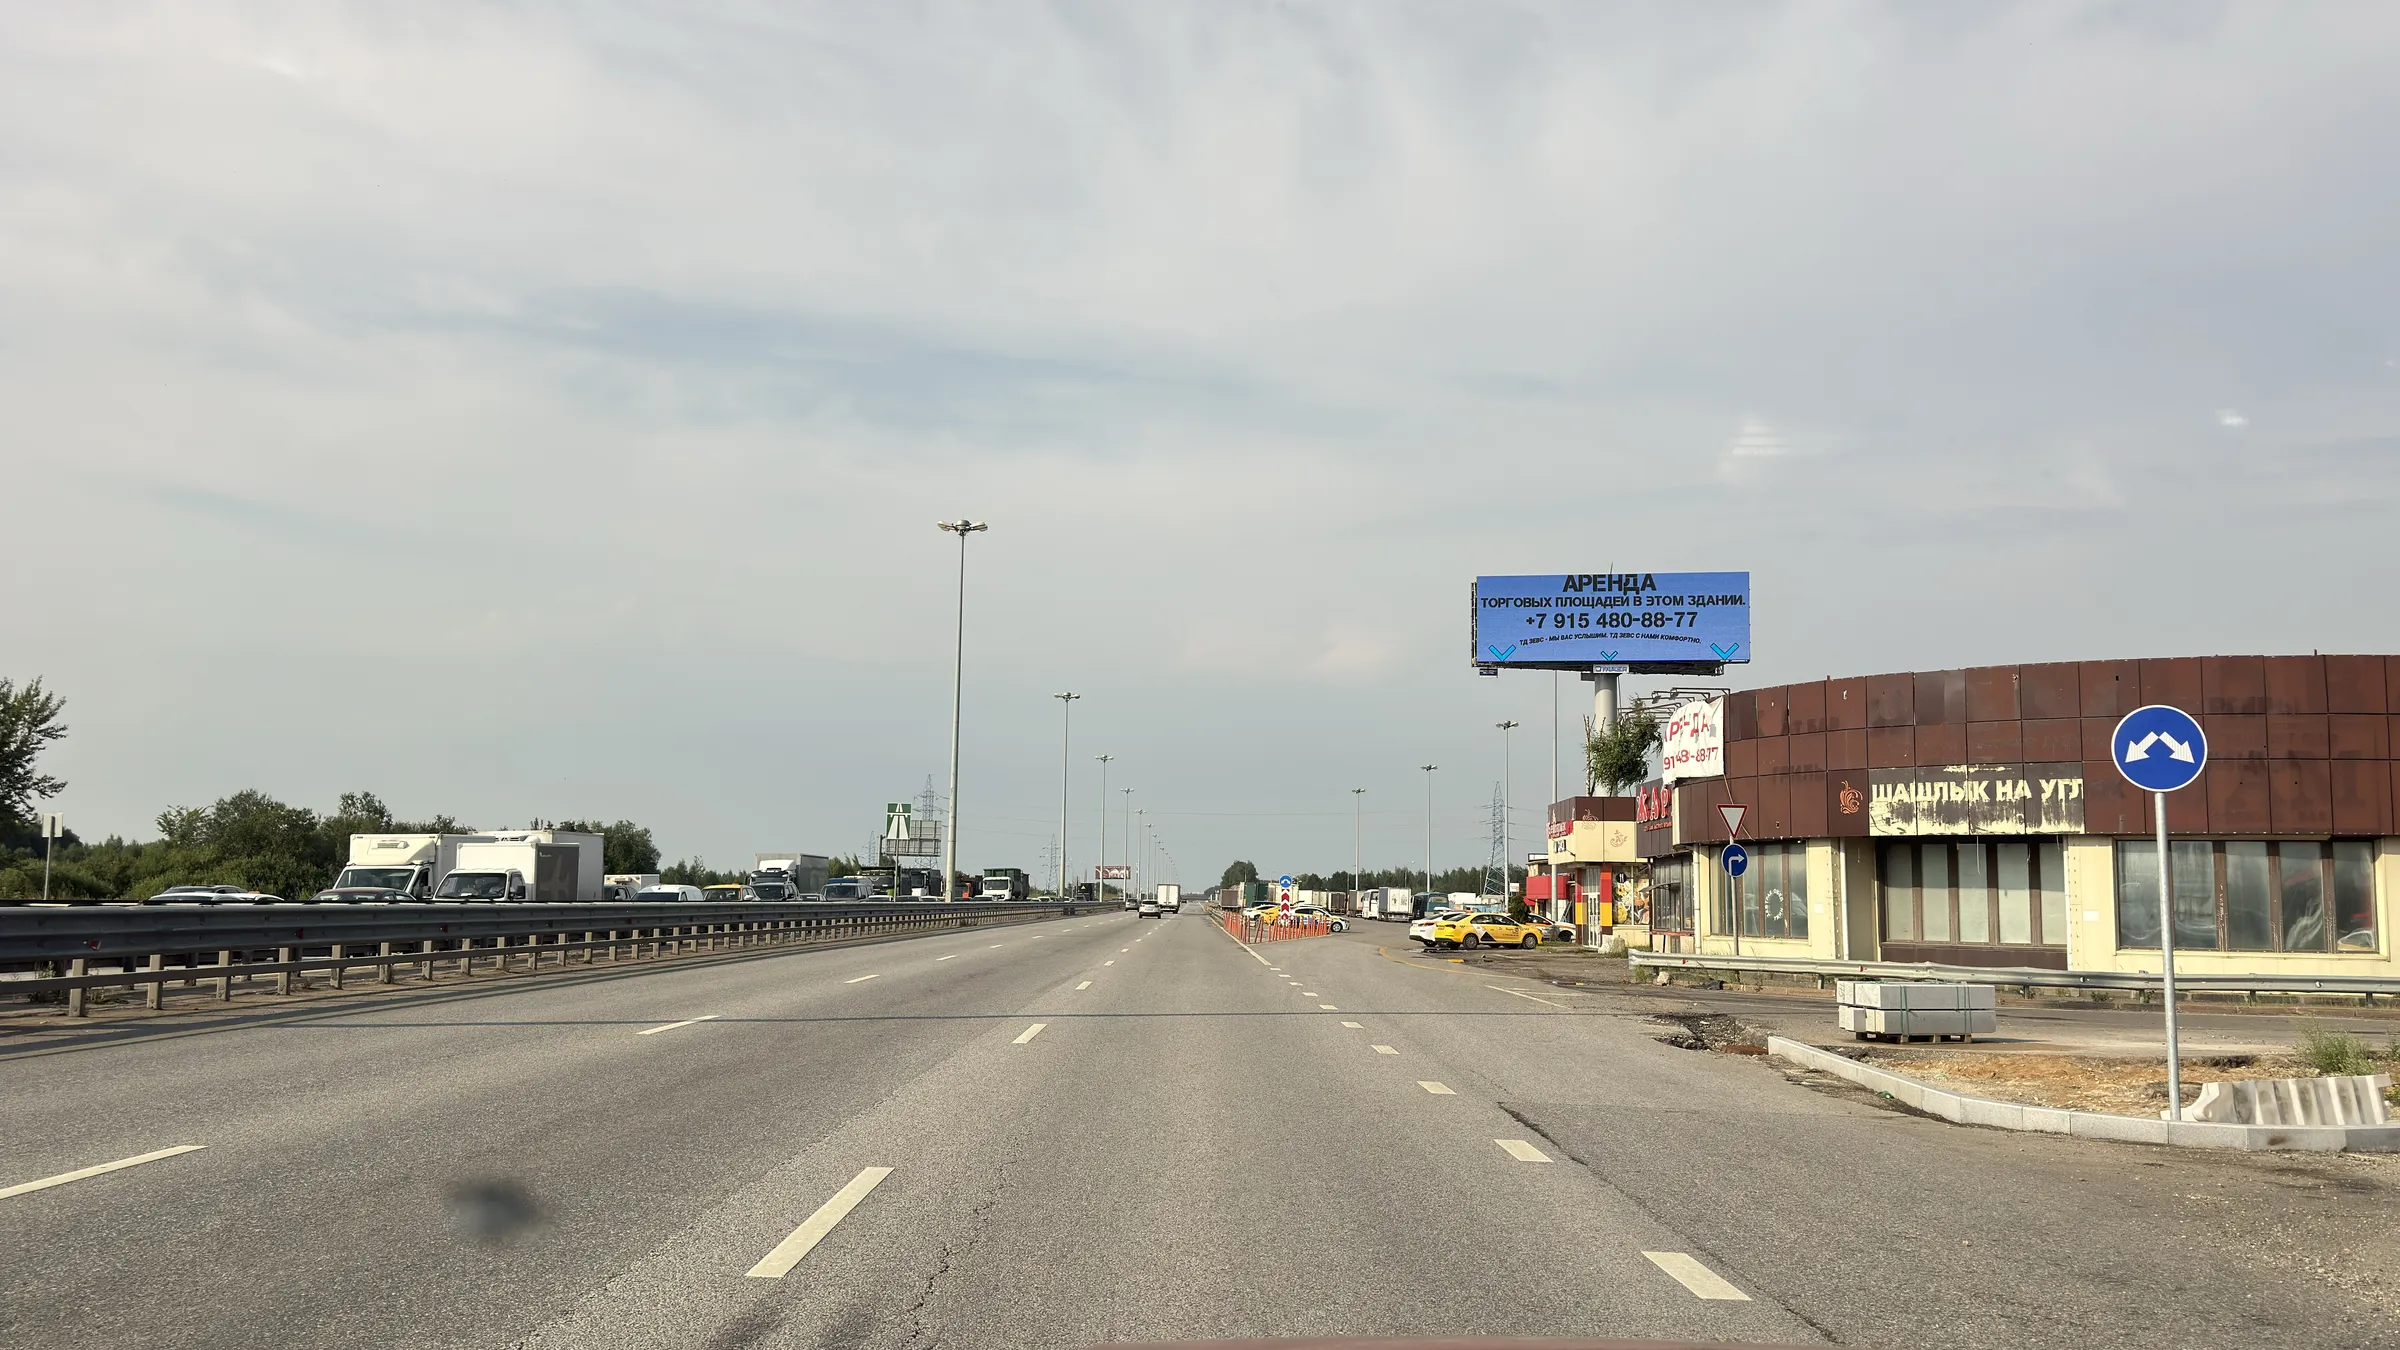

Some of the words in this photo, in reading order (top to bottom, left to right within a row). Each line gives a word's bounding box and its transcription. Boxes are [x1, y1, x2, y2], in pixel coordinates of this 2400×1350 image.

[1562, 574, 1657, 595] АРЕНДА
[1481, 597, 1552, 608] ТОРГОВЫХ
[1555, 595, 1630, 609] ПЛОЩАДЕЙ
[1633, 596, 1642, 606] В
[1646, 595, 1684, 607] ЭТОМ
[1688, 595, 1746, 608] ЗДАНИИ.
[1526, 613, 1547, 629] +7
[1553, 613, 1590, 629] 915
[1596, 612, 1698, 629] 480-88-77
[1560, 633, 1573, 641] ВАС
[1640, 632, 1660, 640] НАМИ
[1871, 780, 1990, 804] ШАШЛЫК
[1995, 779, 2032, 802] НА
[1636, 786, 1672, 823] ЖАР
